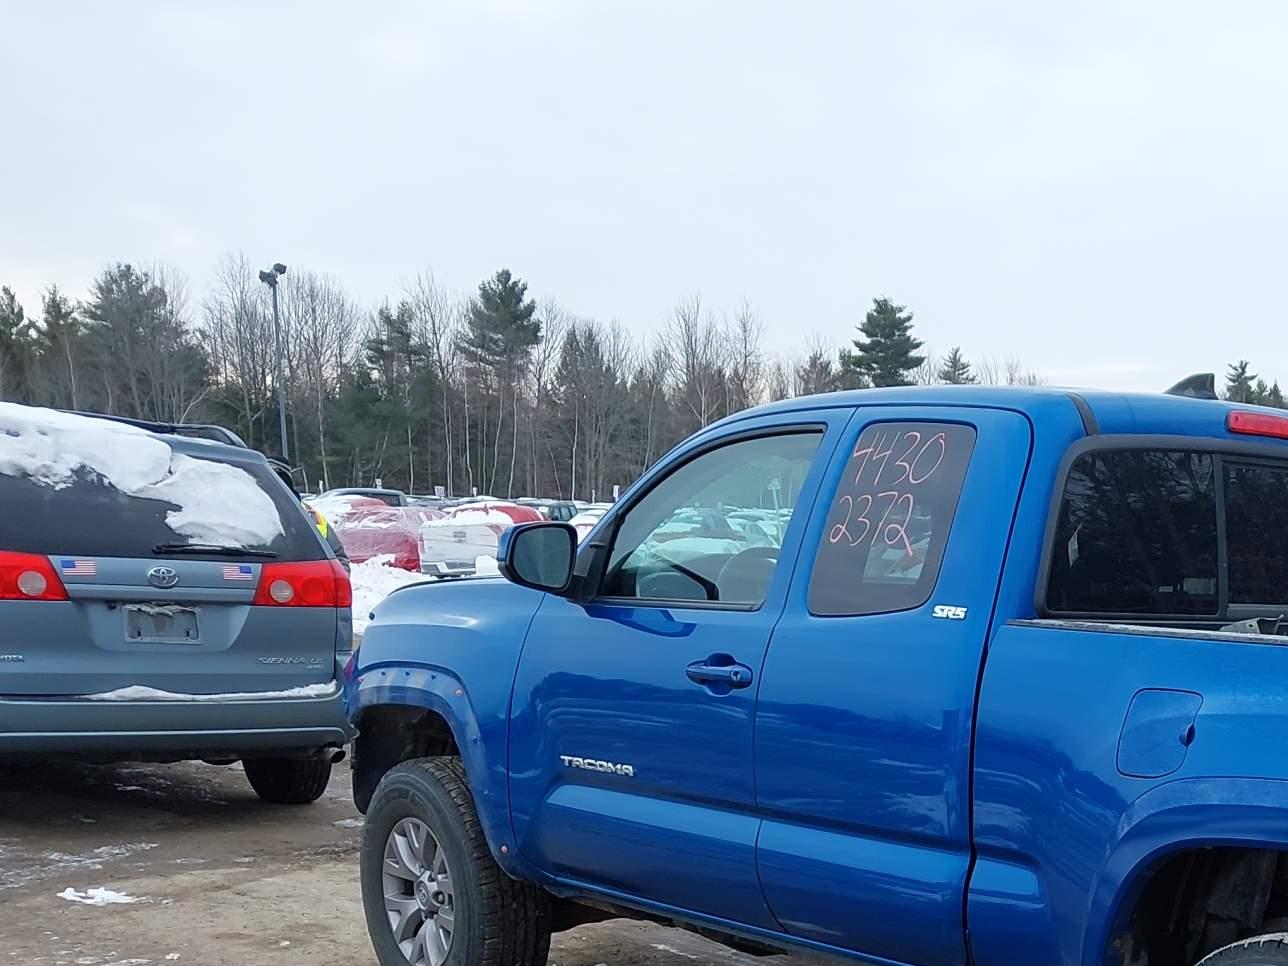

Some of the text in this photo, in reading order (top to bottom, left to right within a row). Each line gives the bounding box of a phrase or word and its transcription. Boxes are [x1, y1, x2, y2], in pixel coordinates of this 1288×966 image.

[852, 431, 946, 487] 4430
[829, 491, 914, 557] 2372
[931, 605, 968, 620] SR5
[256, 656, 306, 665] SIENNA
[559, 754, 635, 777] TACOMA
